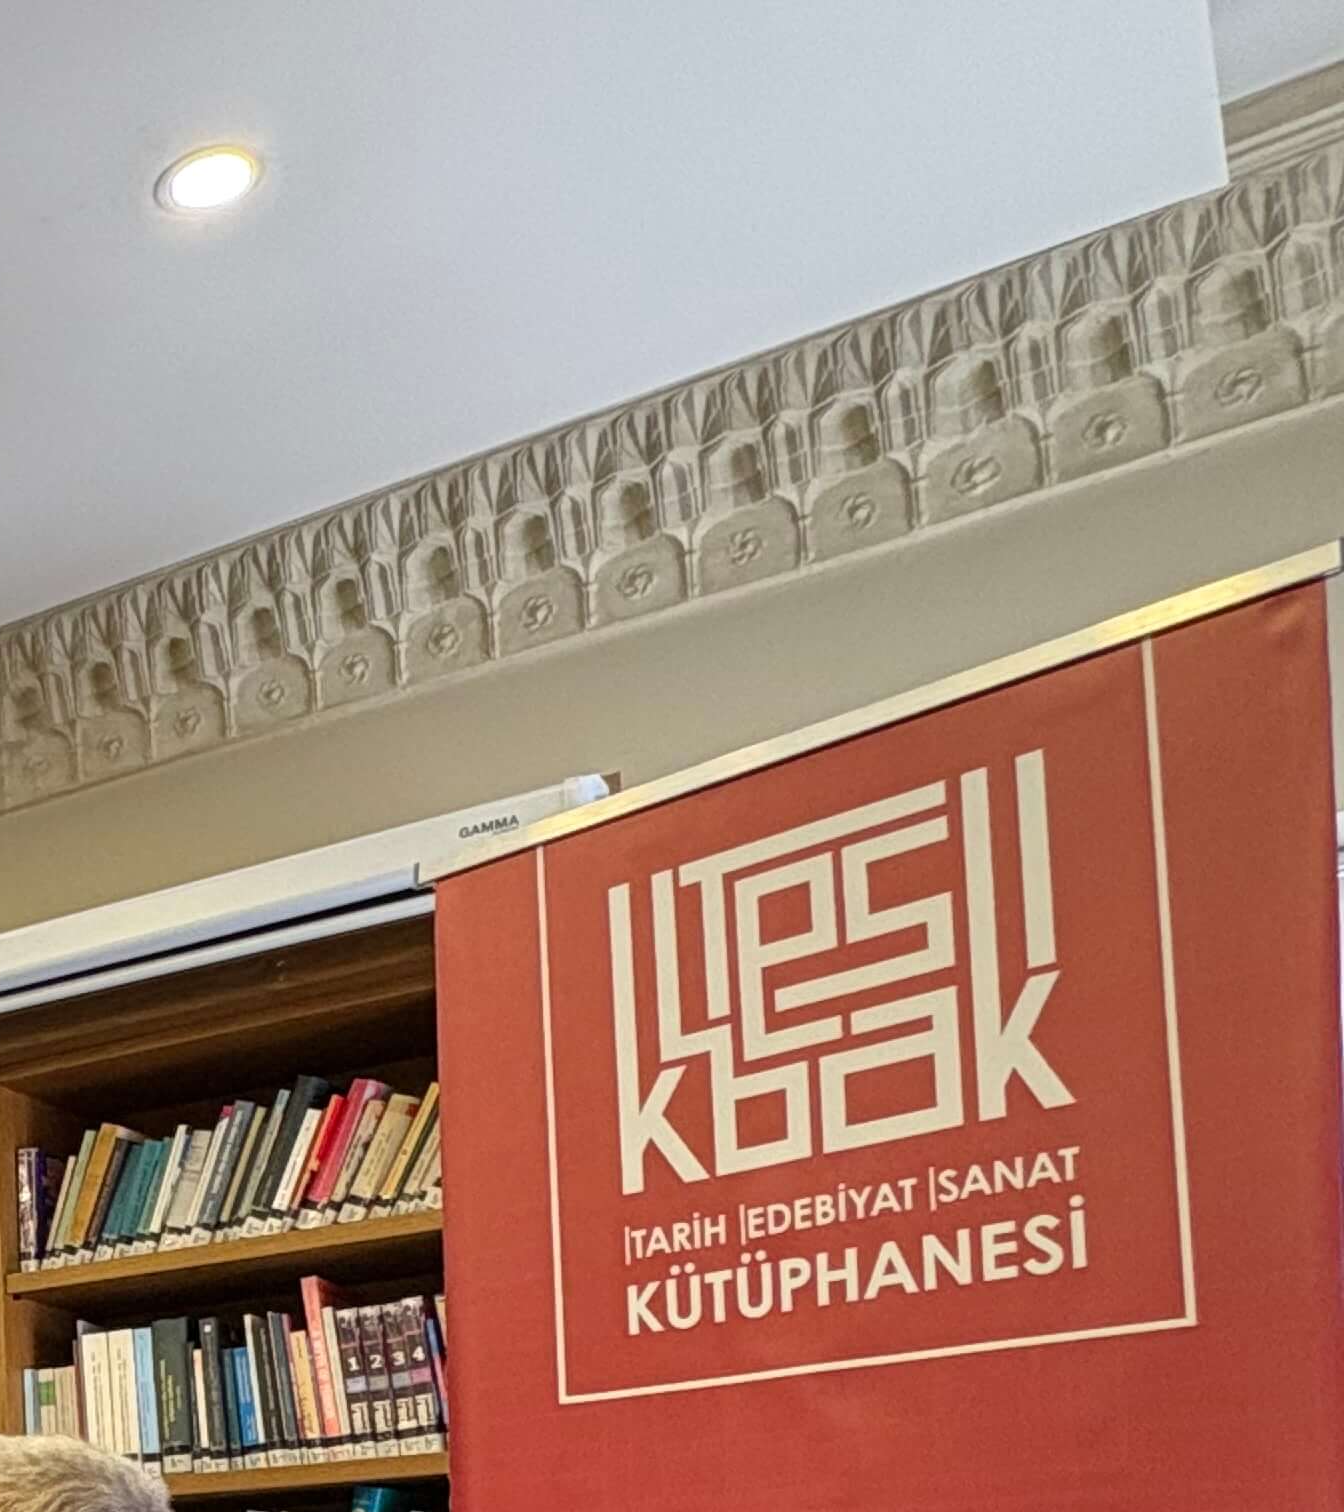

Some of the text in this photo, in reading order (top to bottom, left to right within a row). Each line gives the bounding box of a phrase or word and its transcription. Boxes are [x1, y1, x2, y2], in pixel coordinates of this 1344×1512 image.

[458, 814, 520, 839] GAMMA
[627, 1195, 1089, 1336] KÜTÜPHANESİ
[369, 1354, 384, 1369] 2
[392, 1351, 406, 1366] 3
[412, 1345, 426, 1362] 4
[347, 1356, 360, 1372] 1
